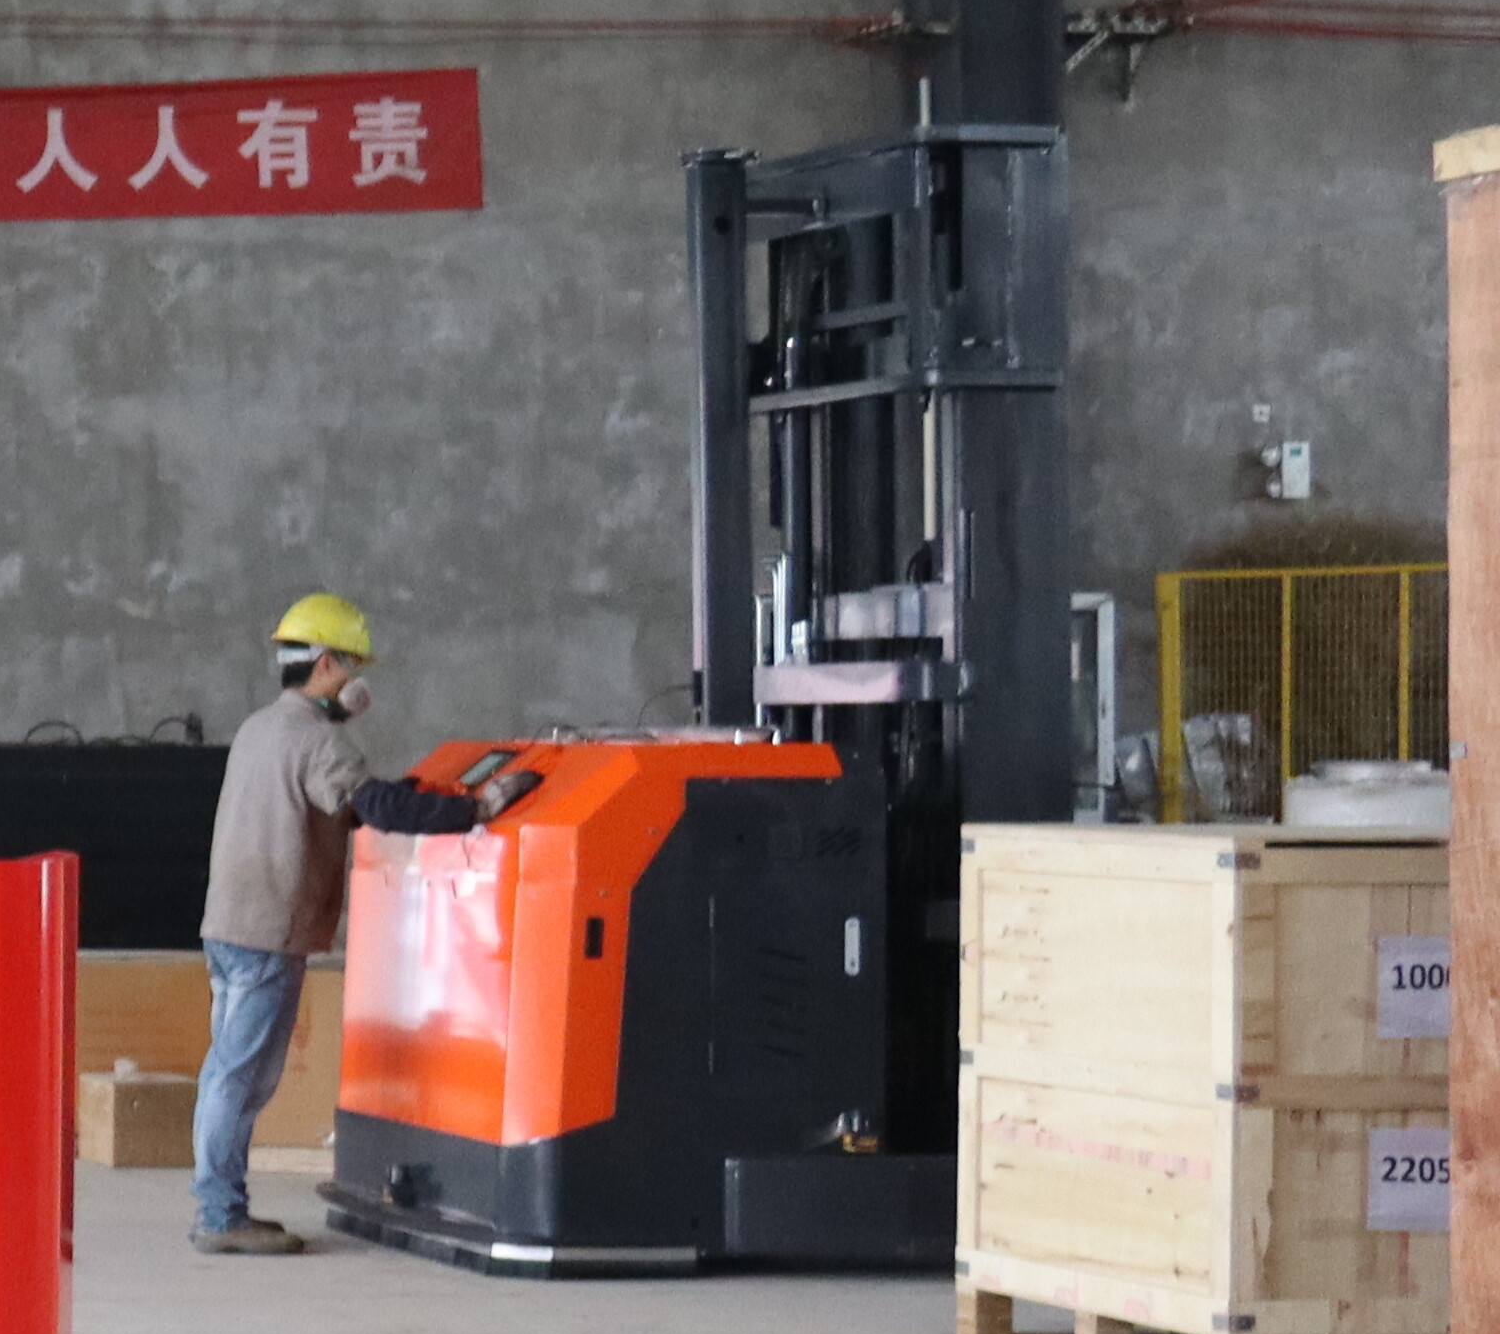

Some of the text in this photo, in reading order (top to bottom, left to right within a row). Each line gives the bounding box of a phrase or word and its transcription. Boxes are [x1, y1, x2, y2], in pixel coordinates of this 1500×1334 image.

[15, 96, 430, 193] 人人有责
[1392, 963, 1450, 990] 100
